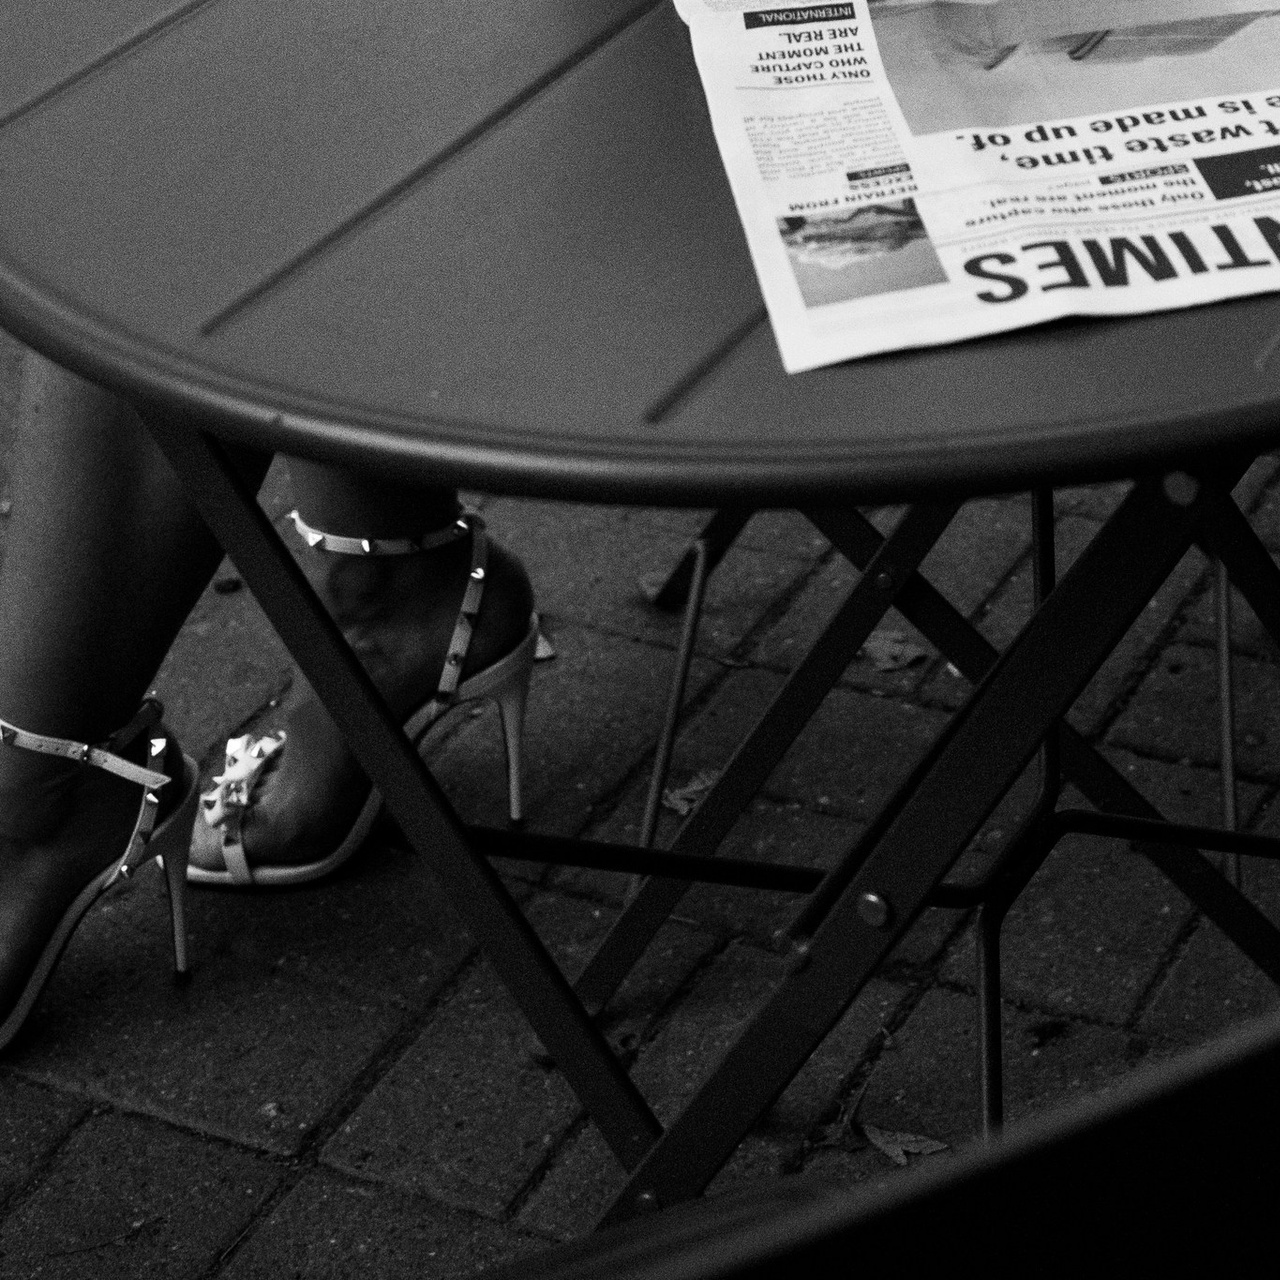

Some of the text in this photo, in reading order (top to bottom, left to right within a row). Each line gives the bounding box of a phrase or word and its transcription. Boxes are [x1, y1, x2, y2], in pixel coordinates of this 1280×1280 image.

[758, 6, 852, 22] INTERNATIONAL
[778, 26, 859, 44] ARE REAL.
[757, 41, 863, 61] THE MOMENT
[752, 56, 868, 73] WHO CAPTURE
[774, 68, 871, 85] ONLY THOSE
[1216, 99, 1256, 114] is
[1089, 105, 1207, 133] made
[956, 133, 1011, 151] of.
[1023, 124, 1077, 143] up
[1124, 123, 1252, 152] waste
[999, 145, 1113, 168] time,
[1162, 177, 1197, 186] the
[788, 184, 919, 211] REFRAIN FROM
[1034, 194, 1068, 202] are
[1073, 182, 1158, 202] moment
[964, 191, 1205, 226] Only those who capture
